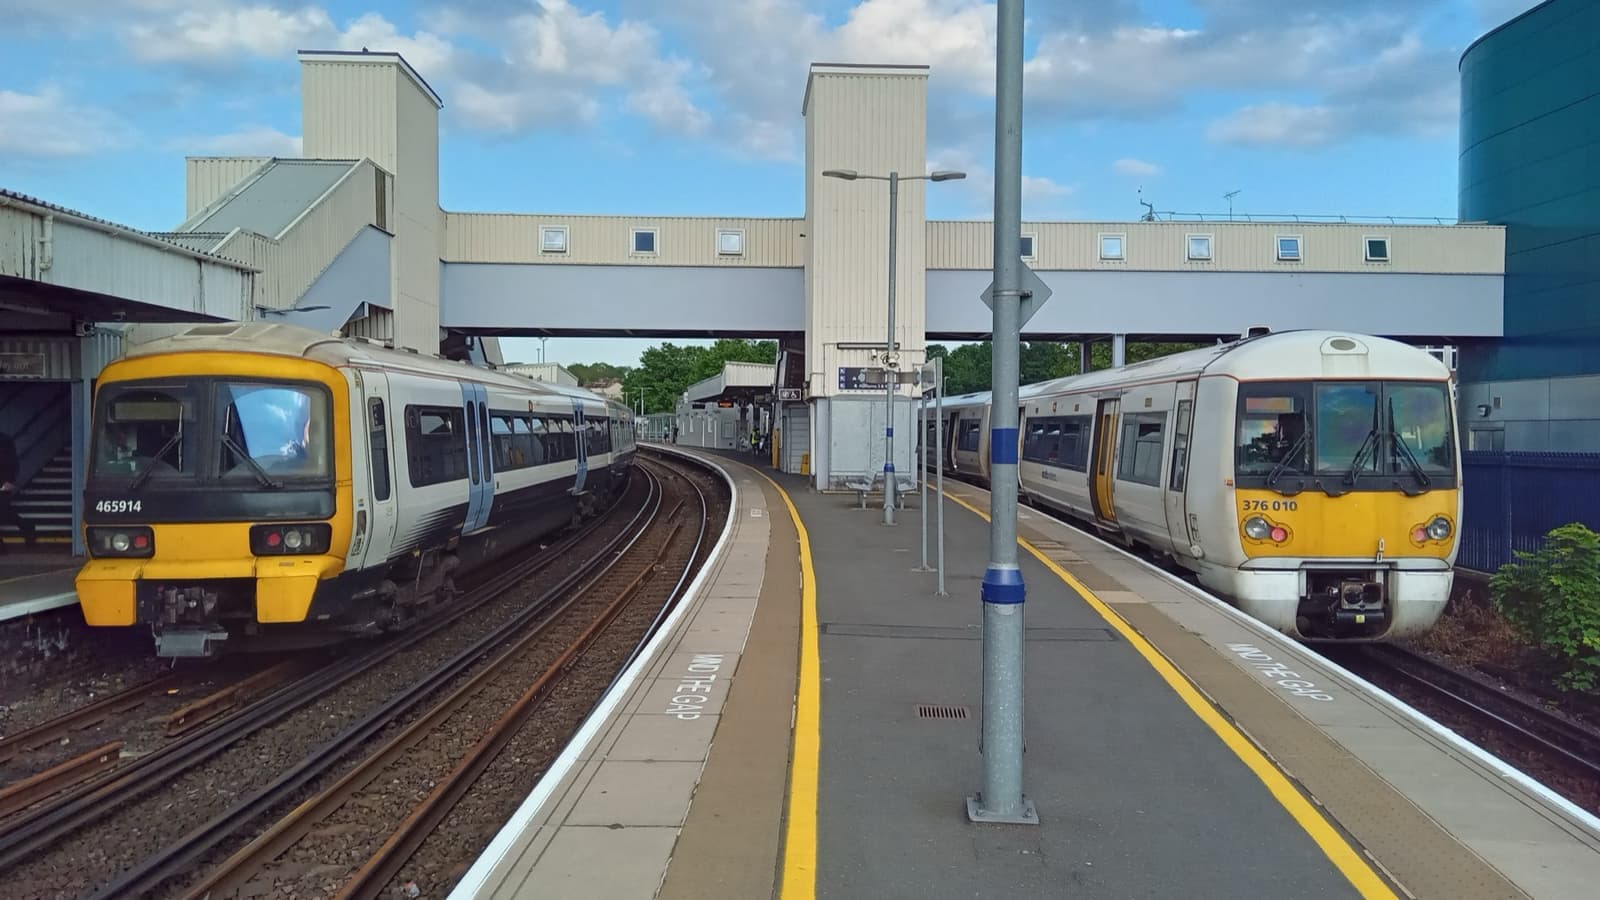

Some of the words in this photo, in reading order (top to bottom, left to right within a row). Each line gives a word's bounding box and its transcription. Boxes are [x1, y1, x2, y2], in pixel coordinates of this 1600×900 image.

[95, 500, 142, 513] 465914
[1242, 500, 1269, 511] 376
[1272, 500, 1298, 512] 010
[676, 674, 716, 693] THE
[1251, 662, 1301, 678] THE
[1276, 679, 1334, 701] GAP
[665, 694, 708, 720] GAP
